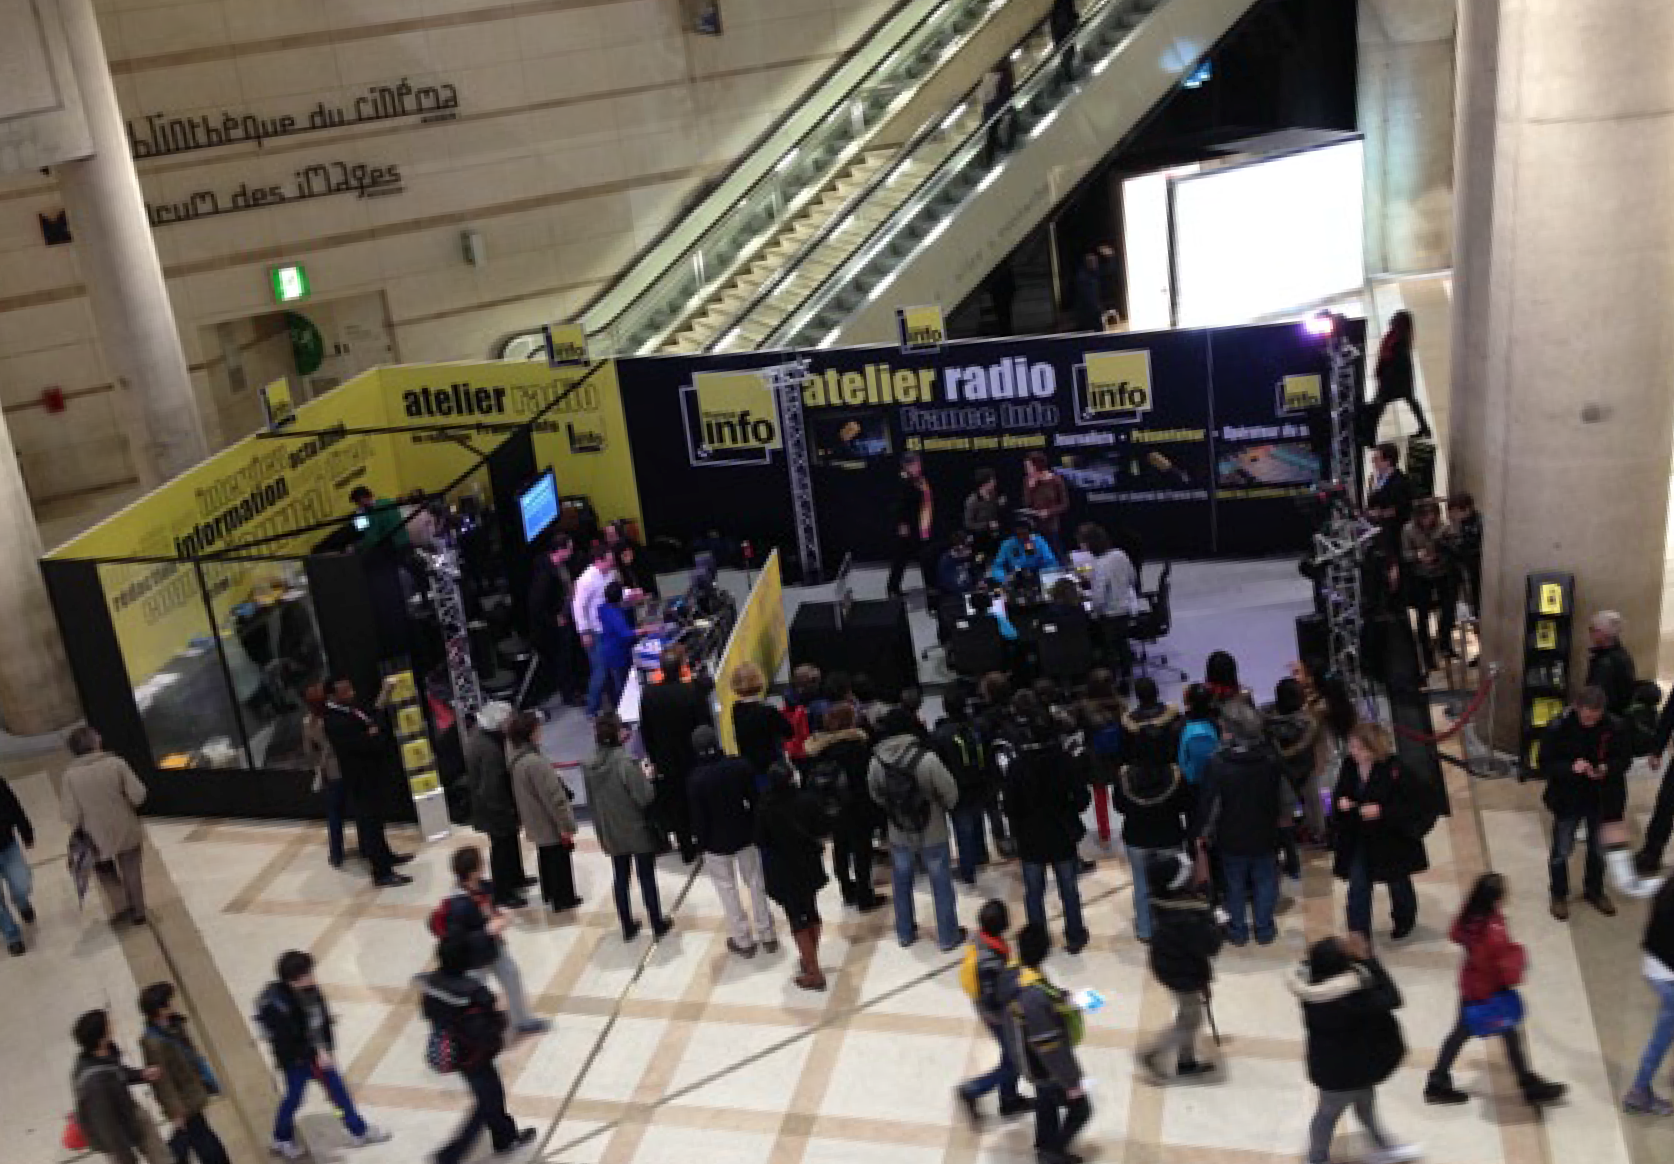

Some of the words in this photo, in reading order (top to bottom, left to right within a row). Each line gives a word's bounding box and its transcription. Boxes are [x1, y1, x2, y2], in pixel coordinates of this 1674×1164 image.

[308, 101, 347, 130] du
[231, 181, 286, 209] des
[802, 362, 937, 407] atelier
[943, 355, 1057, 402] radio
[1091, 381, 1149, 408] info
[402, 381, 507, 418] atelier
[704, 409, 777, 445] info
[173, 475, 290, 559] information
